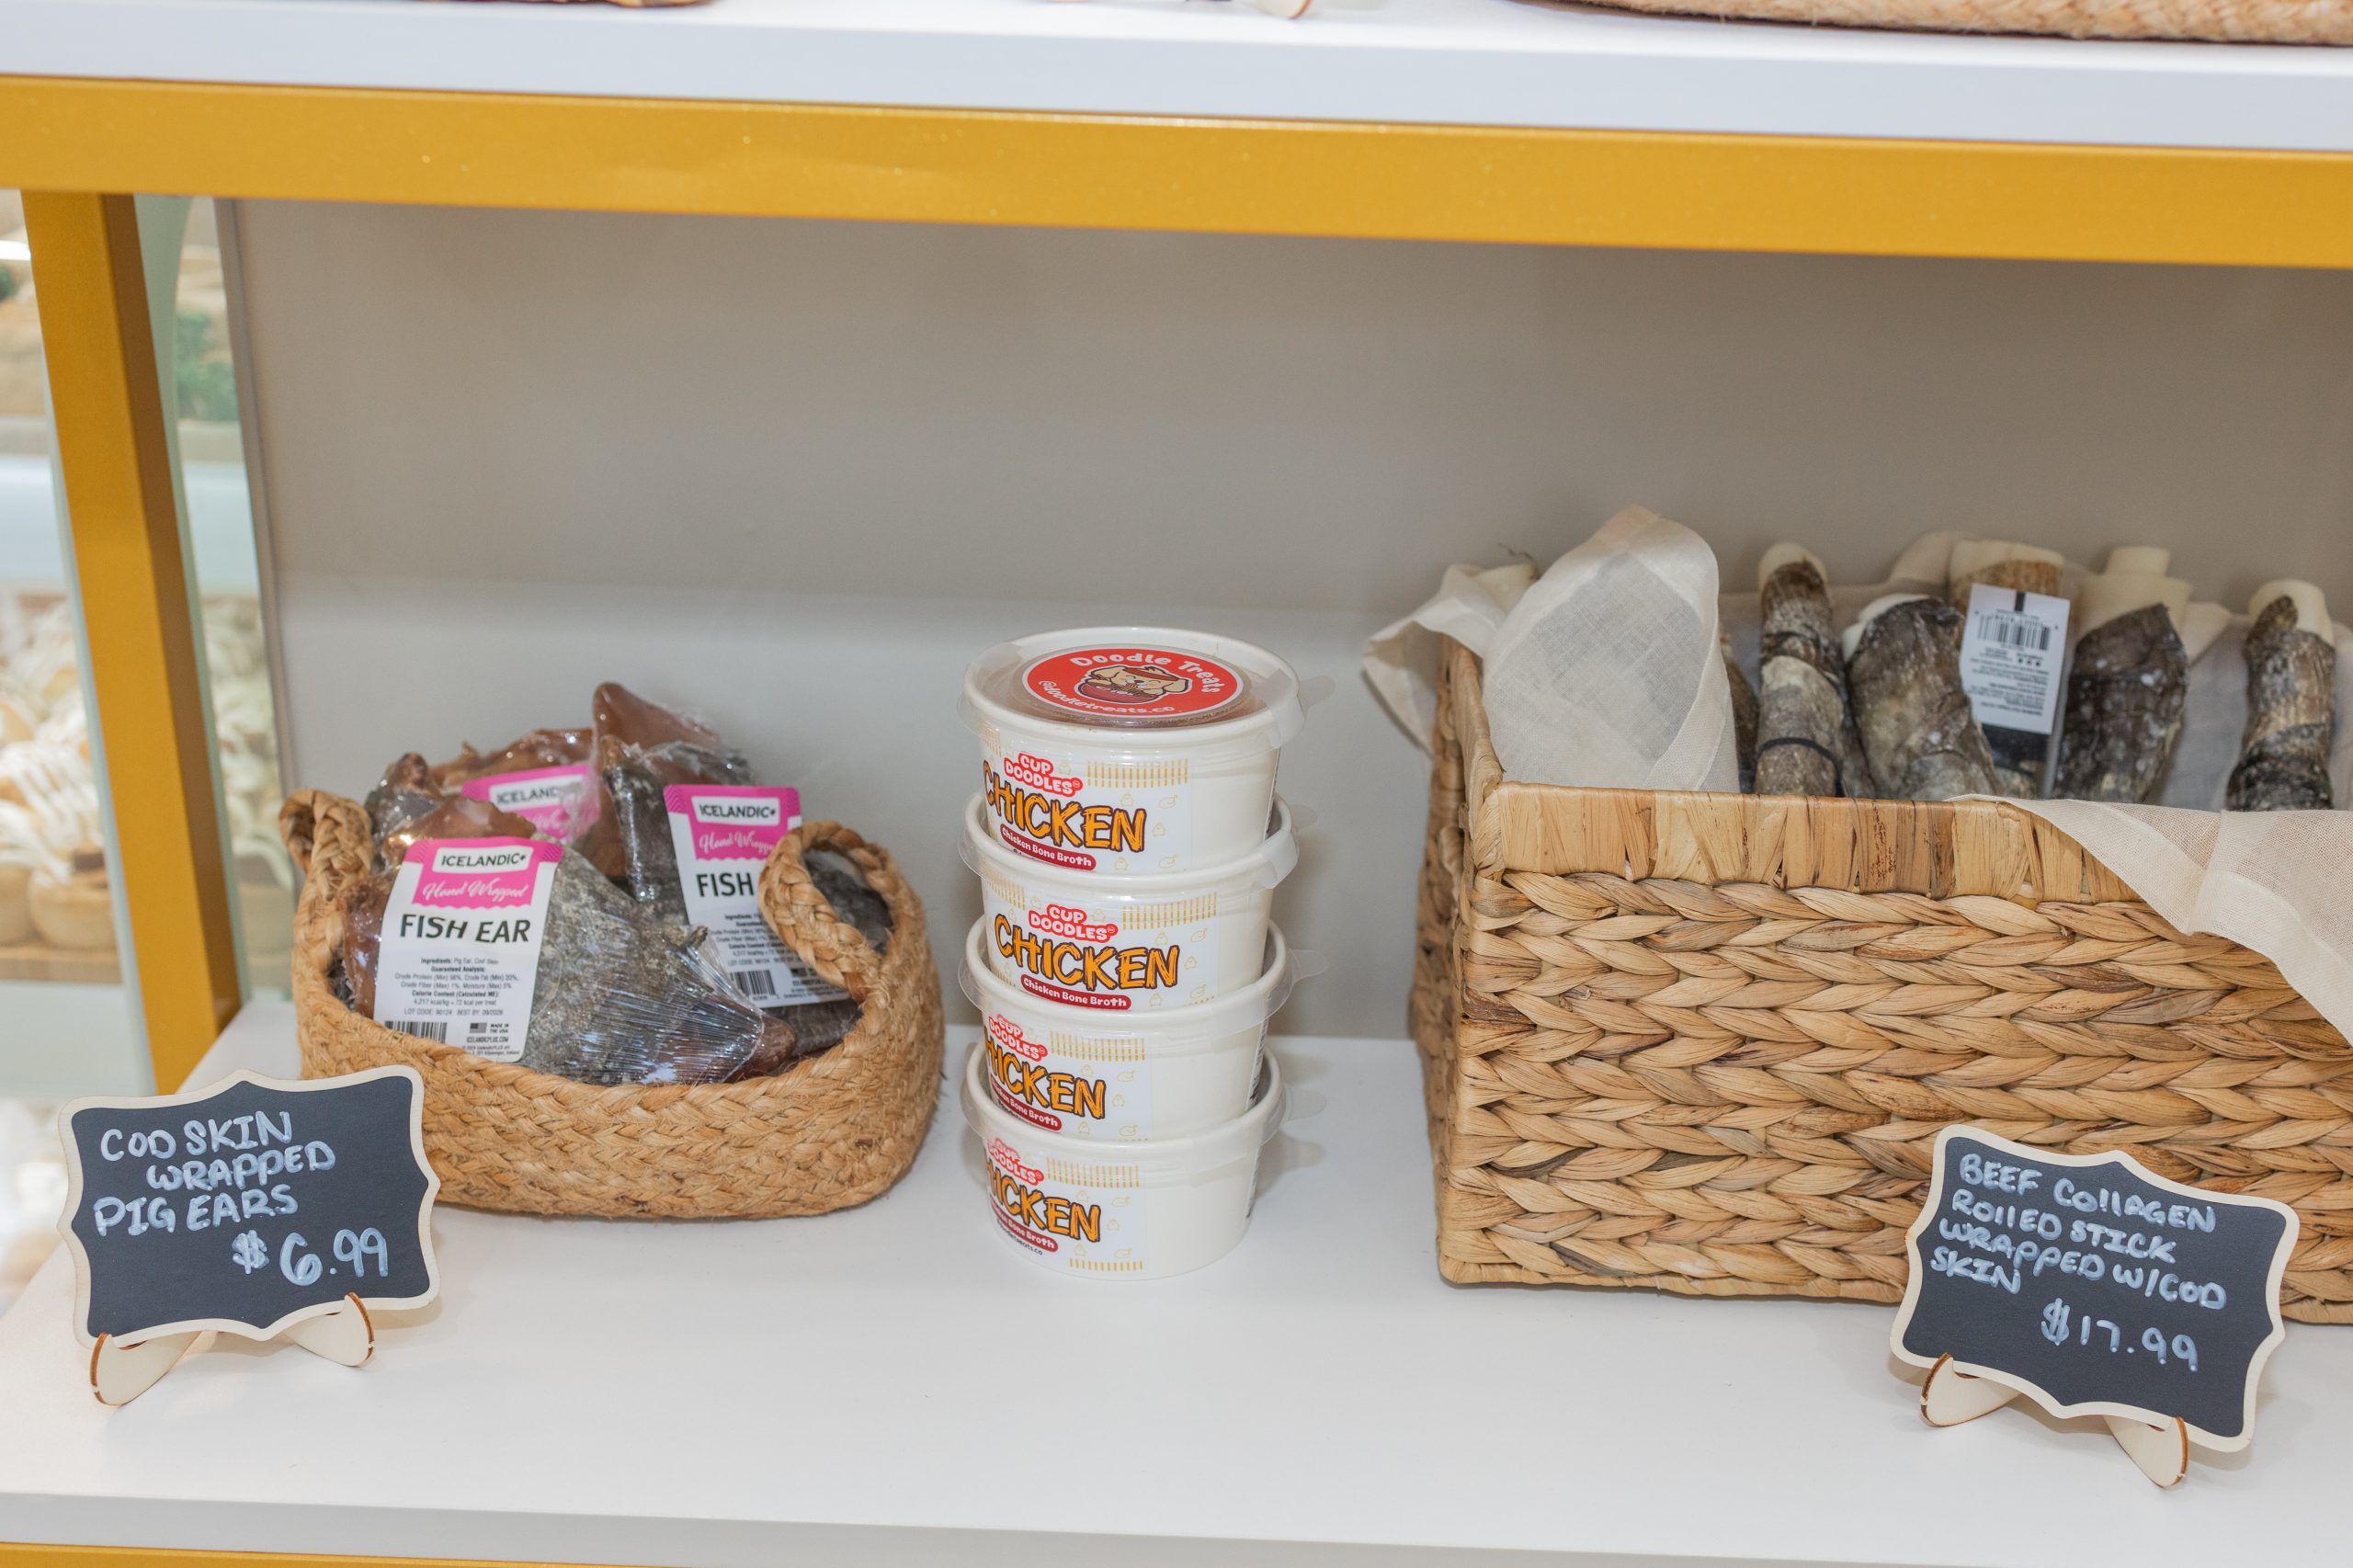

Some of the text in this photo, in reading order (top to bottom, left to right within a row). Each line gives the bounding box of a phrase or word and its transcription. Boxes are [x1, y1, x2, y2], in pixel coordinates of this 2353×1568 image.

[1070, 653, 1225, 693] Doodle Treats
[1038, 680, 1176, 713] @doodletreats.co
[1005, 763, 1074, 794] DOODLES
[1020, 755, 1051, 774] CUP
[983, 759, 1147, 852] CHICKEN
[734, 830, 775, 856] Wrapp
[1002, 827, 1031, 850] Chicken
[1032, 845, 1055, 860] Bone
[1057, 853, 1092, 867] Broth
[423, 877, 529, 902] Hand Wrapped
[696, 872, 755, 897] FISH
[400, 914, 530, 944] FISH EAR
[1030, 914, 1108, 940] DOODLES
[1049, 905, 1085, 924] CUP
[995, 913, 1180, 992] CHICKEN
[1023, 977, 1127, 1007] Chicken Bone Broth
[984, 1028, 1107, 1119] HICKEN
[101, 1110, 292, 1161] COD SKIN
[1029, 1109, 1059, 1127] Broth
[146, 1141, 335, 1191] WRAPPED
[1960, 1153, 2043, 1197] BEEF
[94, 1184, 299, 1236] PIG EARS
[1027, 1231, 1055, 1248] Broth
[1939, 1217, 2106, 1280] WRAPPED
[2071, 1219, 2177, 1264] STICK
[1930, 1245, 2021, 1295] SKIN
[2041, 1298, 2200, 1372] $17.99
